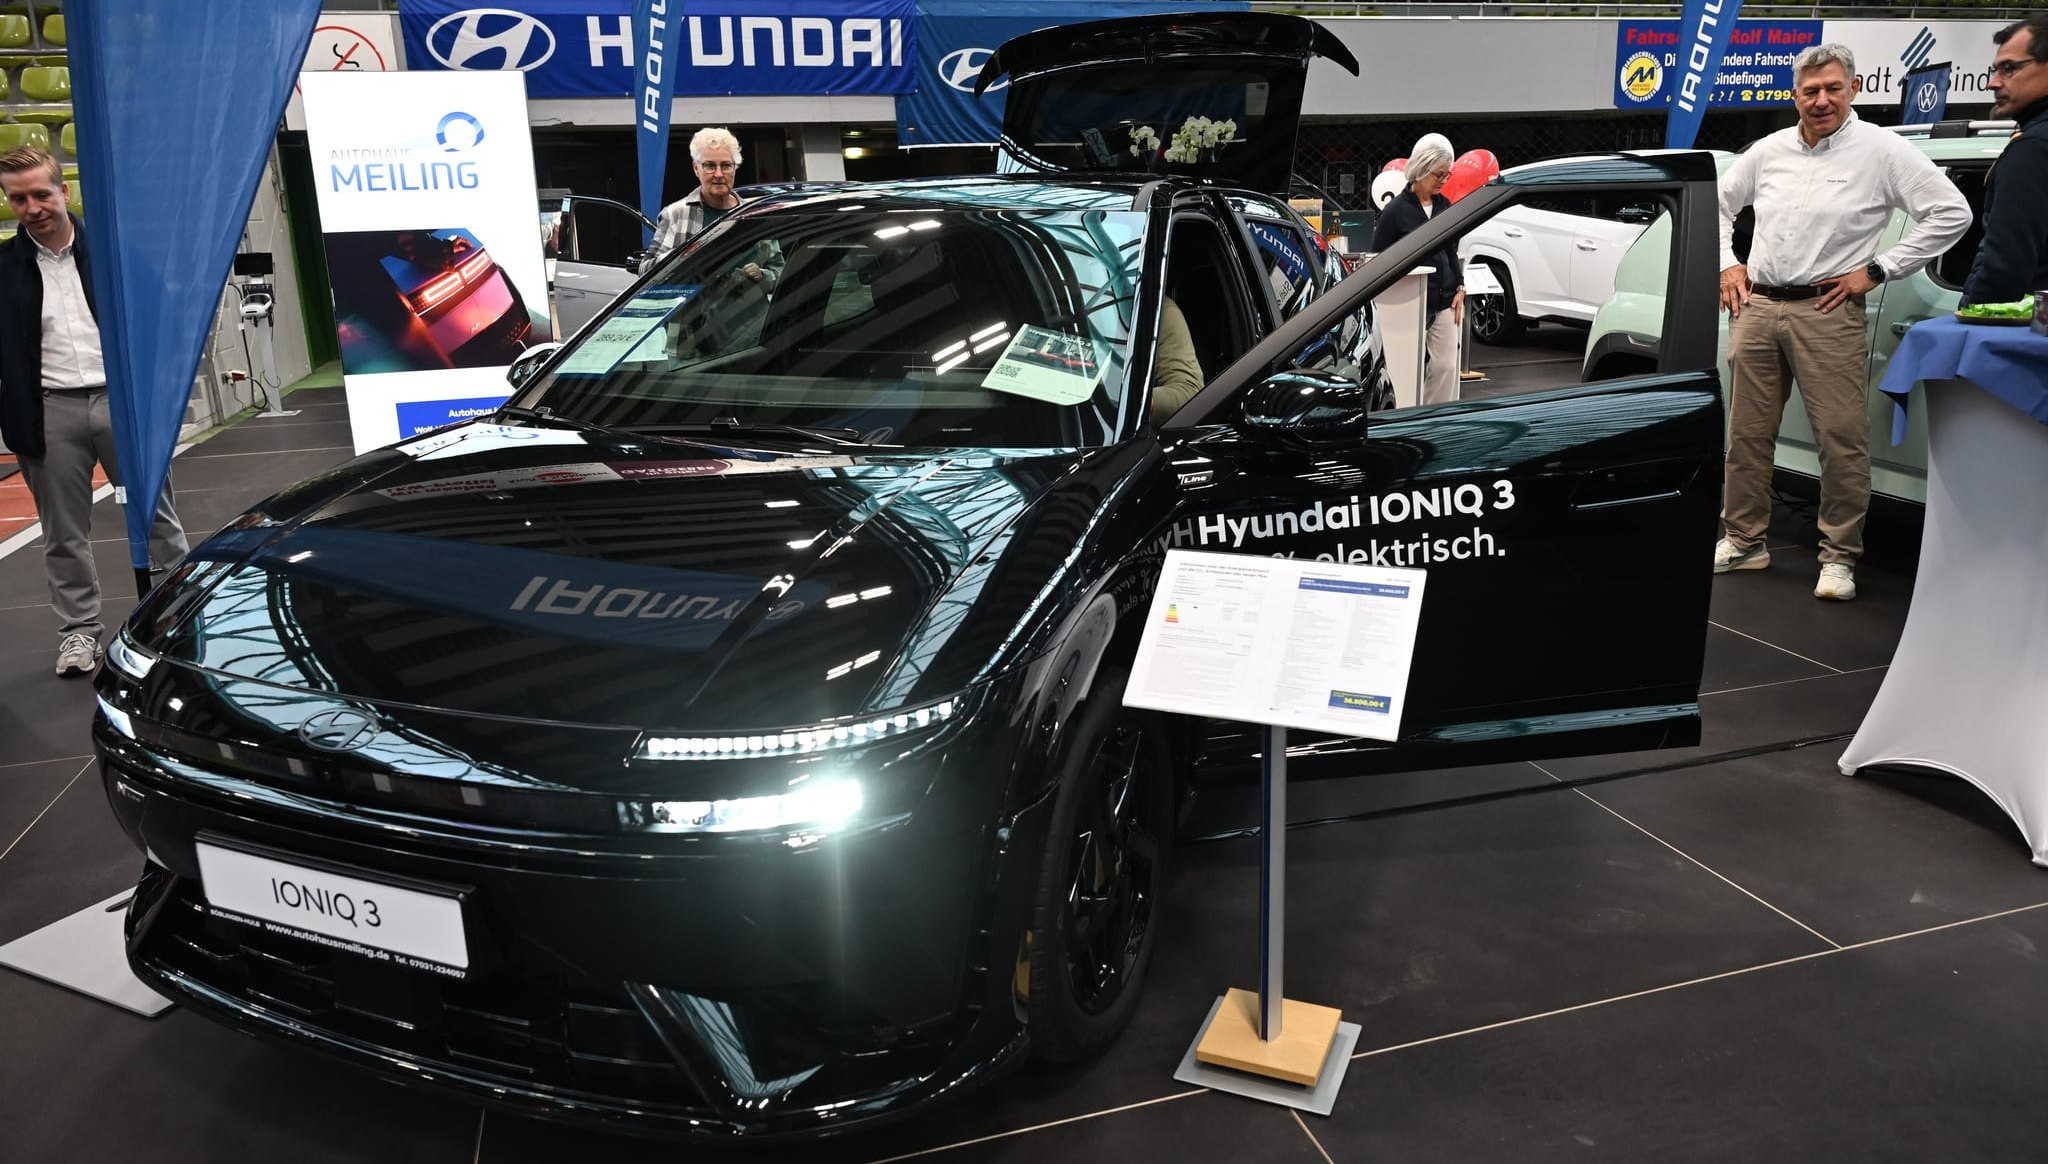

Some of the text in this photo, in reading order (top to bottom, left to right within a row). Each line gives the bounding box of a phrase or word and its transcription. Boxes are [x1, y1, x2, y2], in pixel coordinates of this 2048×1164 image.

[586, 15, 902, 68] HUNDAI
[1626, 27, 1815, 45] Fahrs Rolf Maier
[1664, 52, 1797, 67] Di ndere Fahrsch
[1948, 66, 1993, 93] ind
[1756, 89, 1795, 101] 8799
[330, 161, 480, 193] MEILING
[448, 406, 496, 418] Autohaus
[1199, 479, 1516, 548] Hyundai IONIQ 3
[271, 877, 382, 928] IONIQ 3
[265, 921, 390, 961] www.autohausmeiling.de
